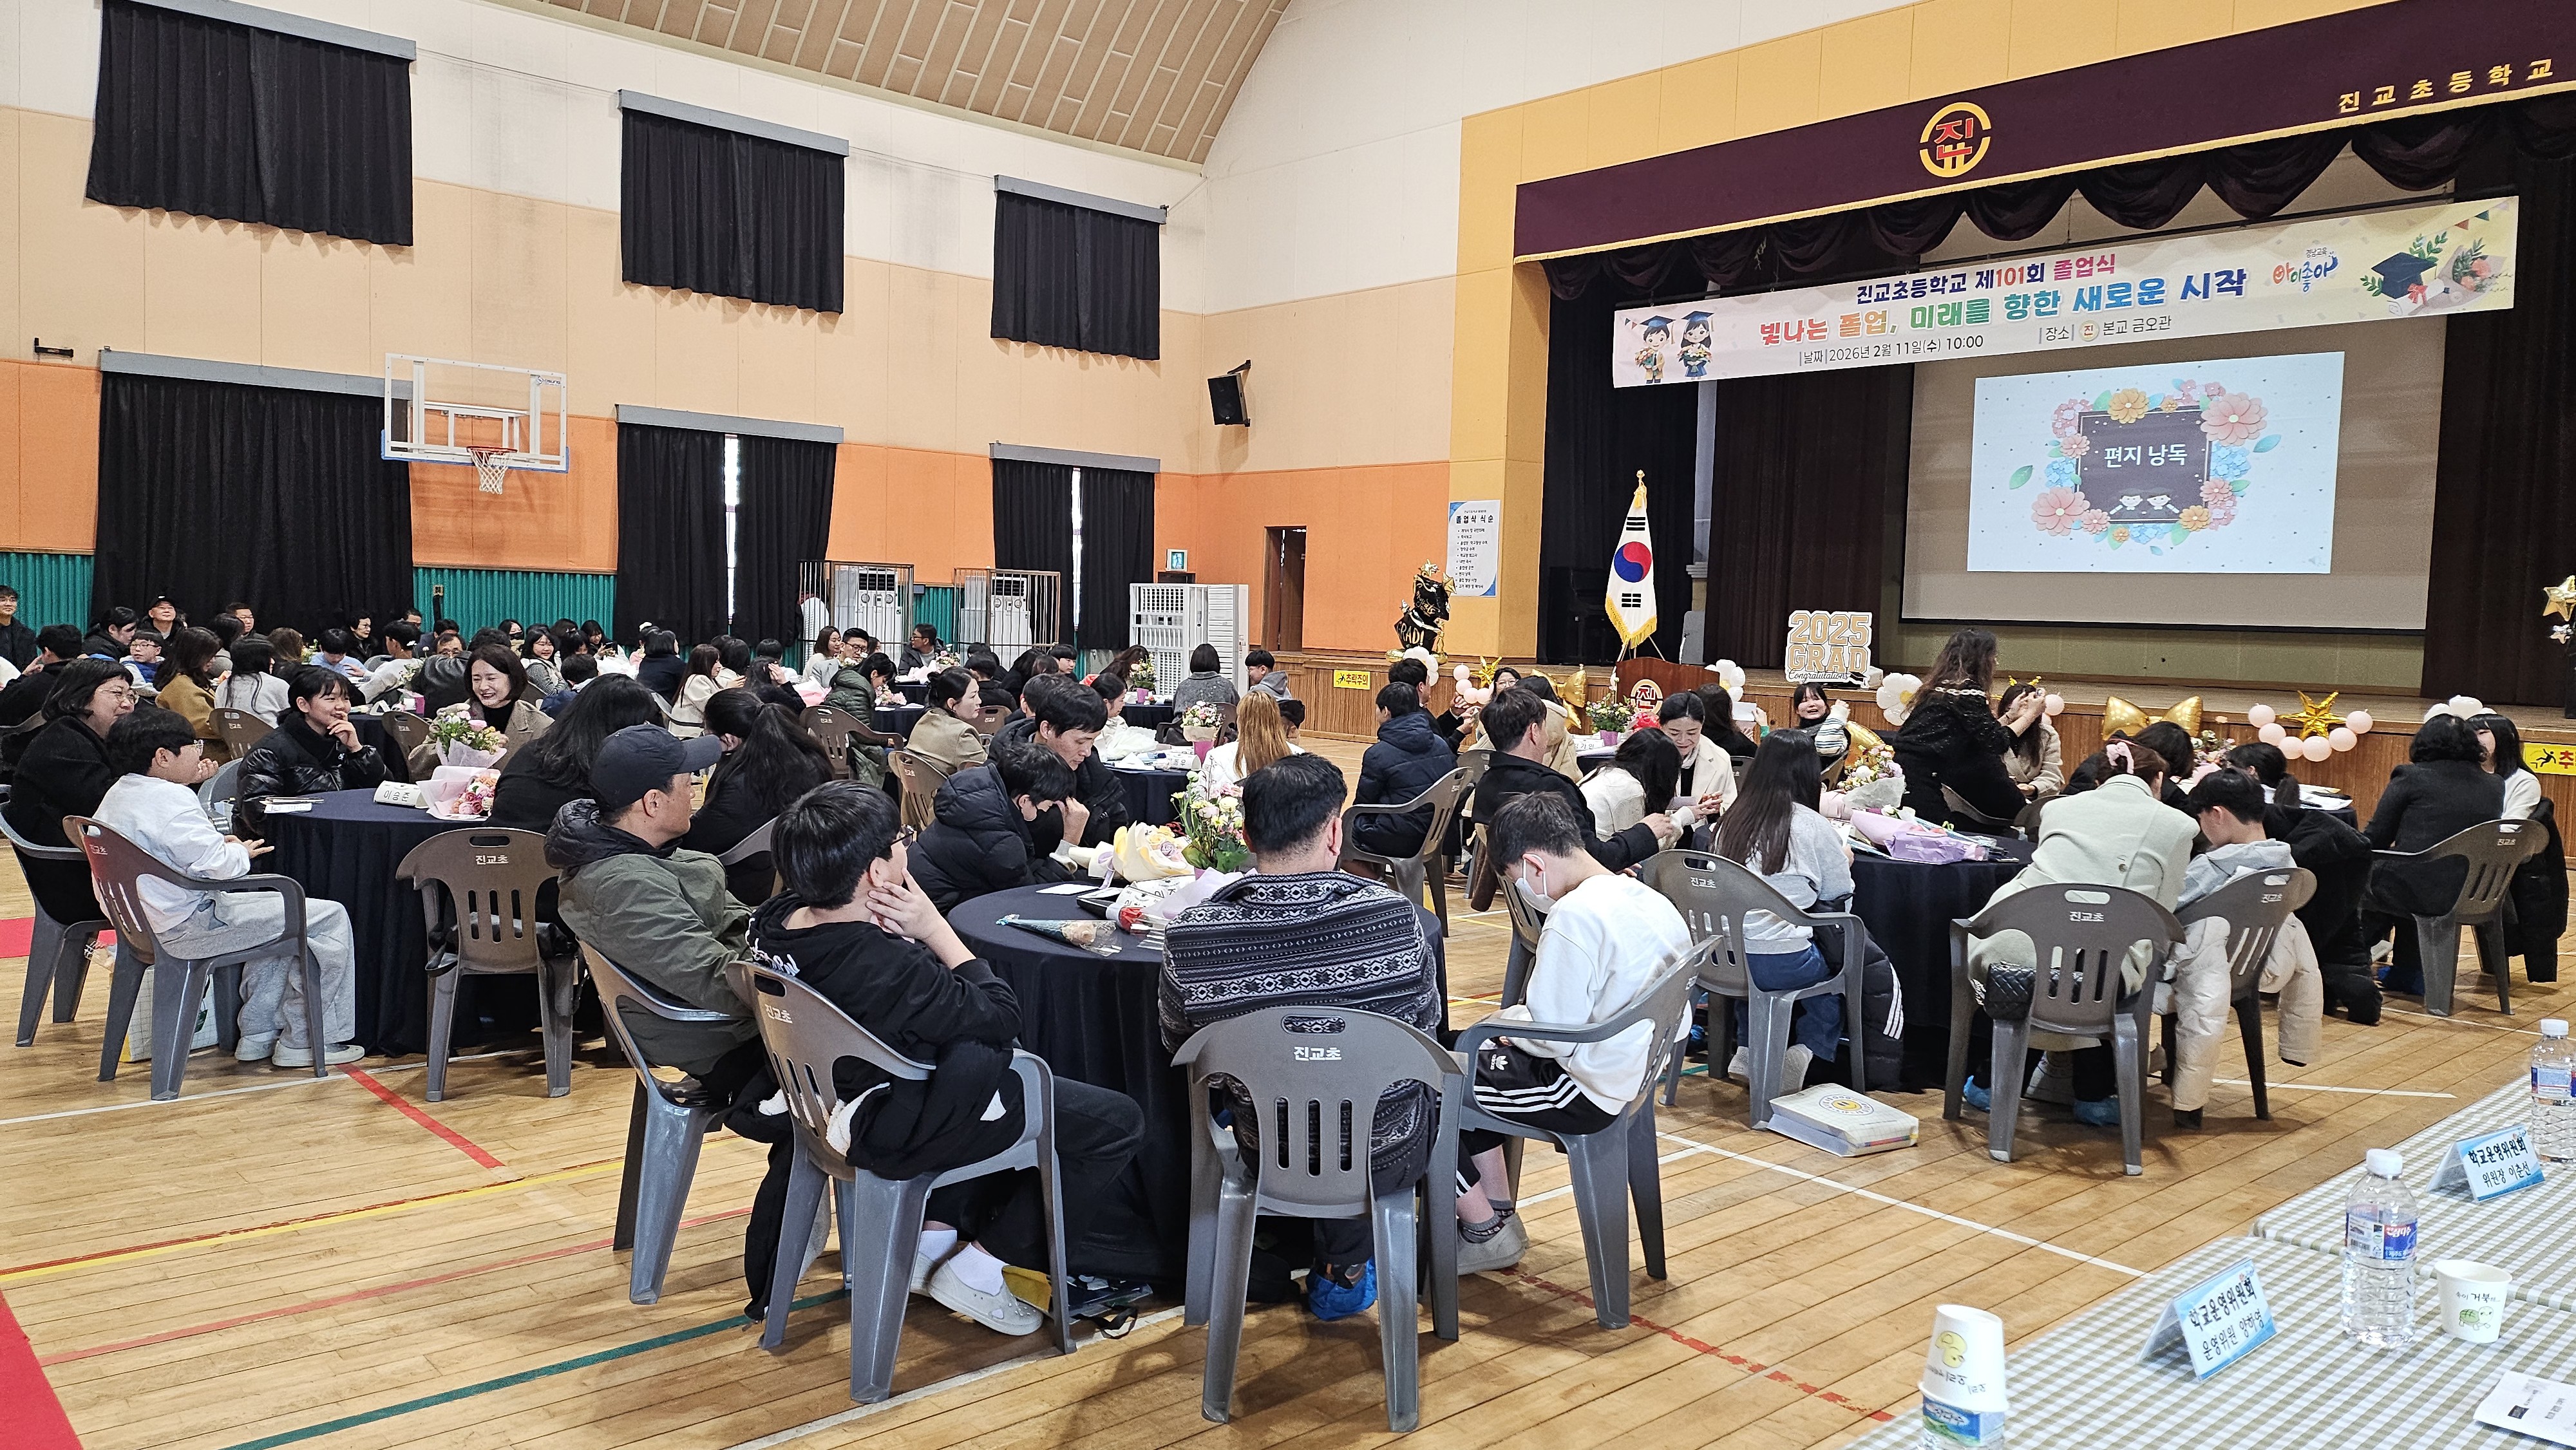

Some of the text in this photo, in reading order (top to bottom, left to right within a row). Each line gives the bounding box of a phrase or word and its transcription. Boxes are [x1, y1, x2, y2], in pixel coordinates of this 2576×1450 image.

[1857, 254, 2116, 305] 진교초등학교 제101회 졸업식
[2273, 256, 2338, 293] 아이좋아
[1760, 268, 2247, 346] 빛나는 졸업, 미래를 향한 새로운 시작
[1873, 343, 1892, 358] 2월
[1897, 337, 1942, 355] 11일(수)
[1946, 335, 1984, 351] 10:00
[2103, 321, 2127, 335] 본교
[2132, 315, 2172, 332] 금오관
[2104, 444, 2188, 468] 편지 낭독
[1397, 621, 1425, 646] GRAD!
[1790, 612, 1870, 646] 2025
[1788, 643, 1868, 674] GRAD
[1346, 673, 1368, 686] 추락주의
[475, 854, 509, 865] 진교초
[1690, 876, 1717, 889] 진교초
[2260, 893, 2283, 903] 진교초
[2069, 911, 2105, 922] 진교초
[764, 1004, 793, 1024] 진교초
[1294, 1046, 1342, 1061] 진교초
[2468, 1137, 2528, 1169] 학교운영위원회
[2483, 1169, 2507, 1188] 위원장
[2188, 1277, 2257, 1332] 학교운영위원회
[2202, 1324, 2238, 1361] 운영위원
